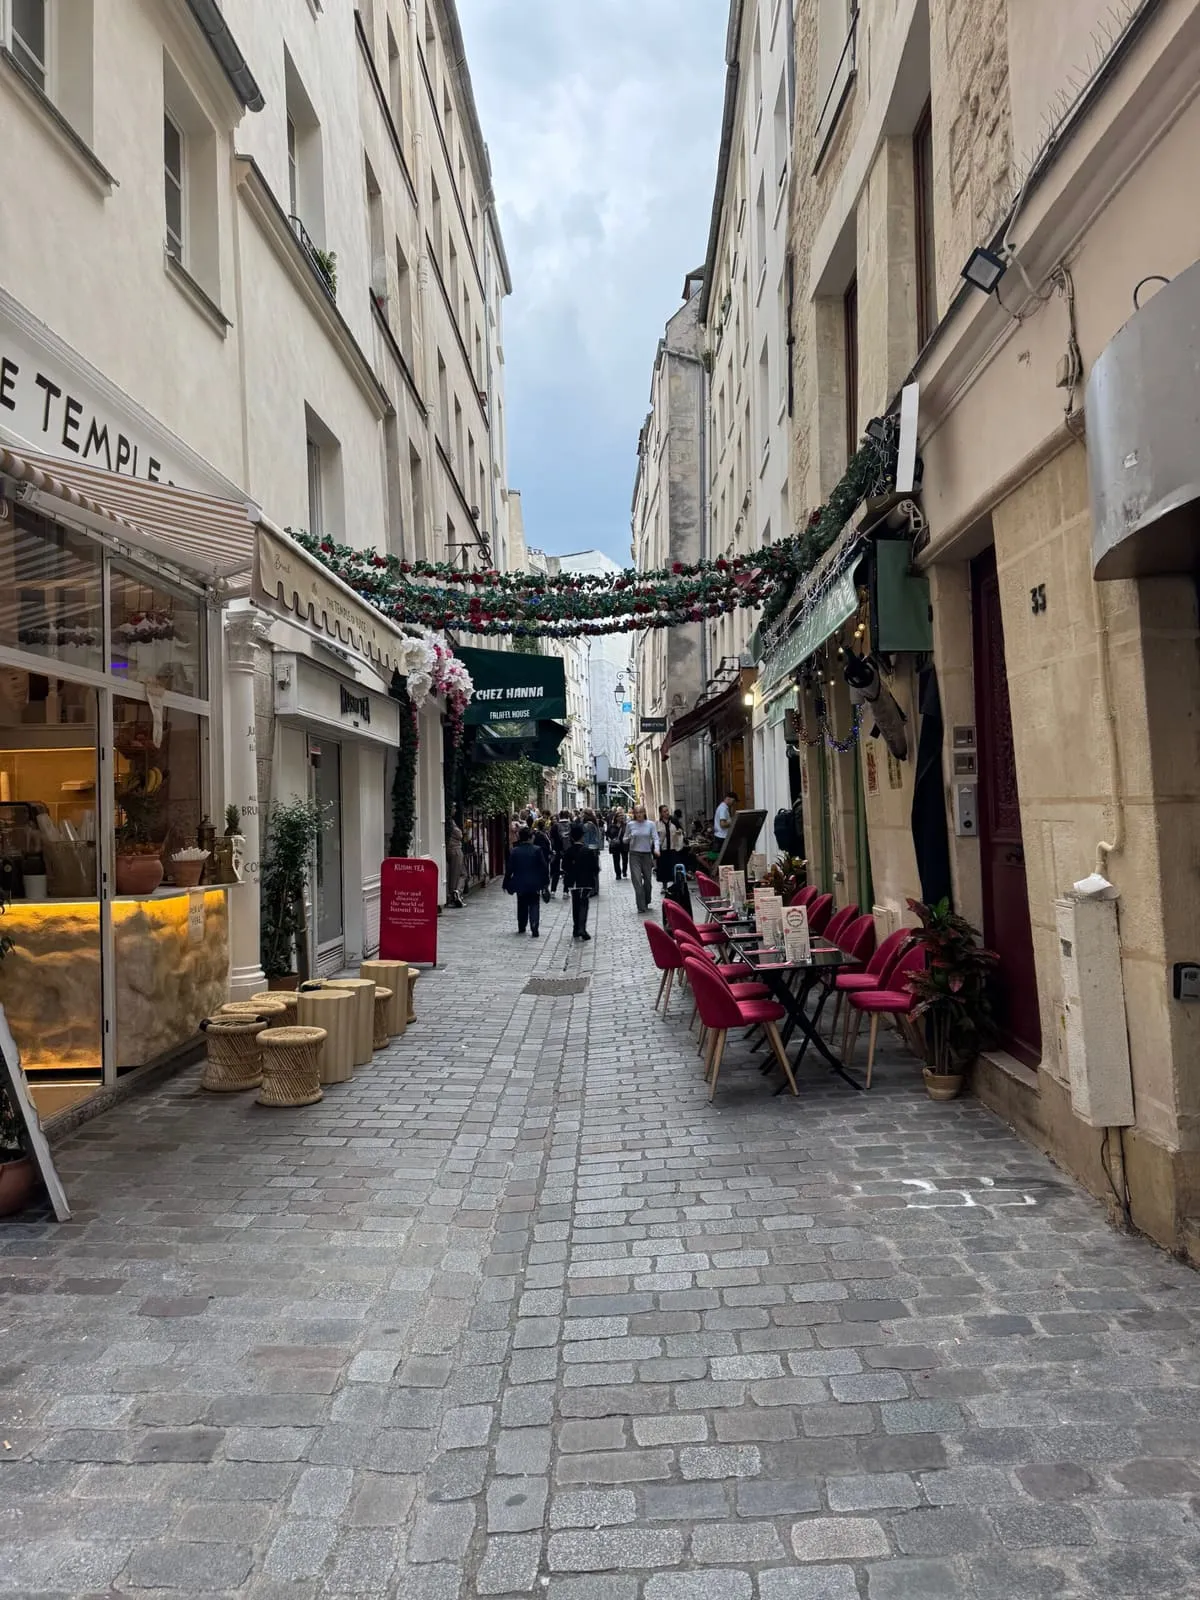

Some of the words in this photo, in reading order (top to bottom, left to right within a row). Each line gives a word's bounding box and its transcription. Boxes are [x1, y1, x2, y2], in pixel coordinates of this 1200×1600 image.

[1030, 583, 1047, 615] 35
[476, 688, 504, 700] CHEZ
[506, 686, 544, 698] HANNA
[489, 710, 511, 720] FALAFEL
[511, 709, 530, 719] HOUSE
